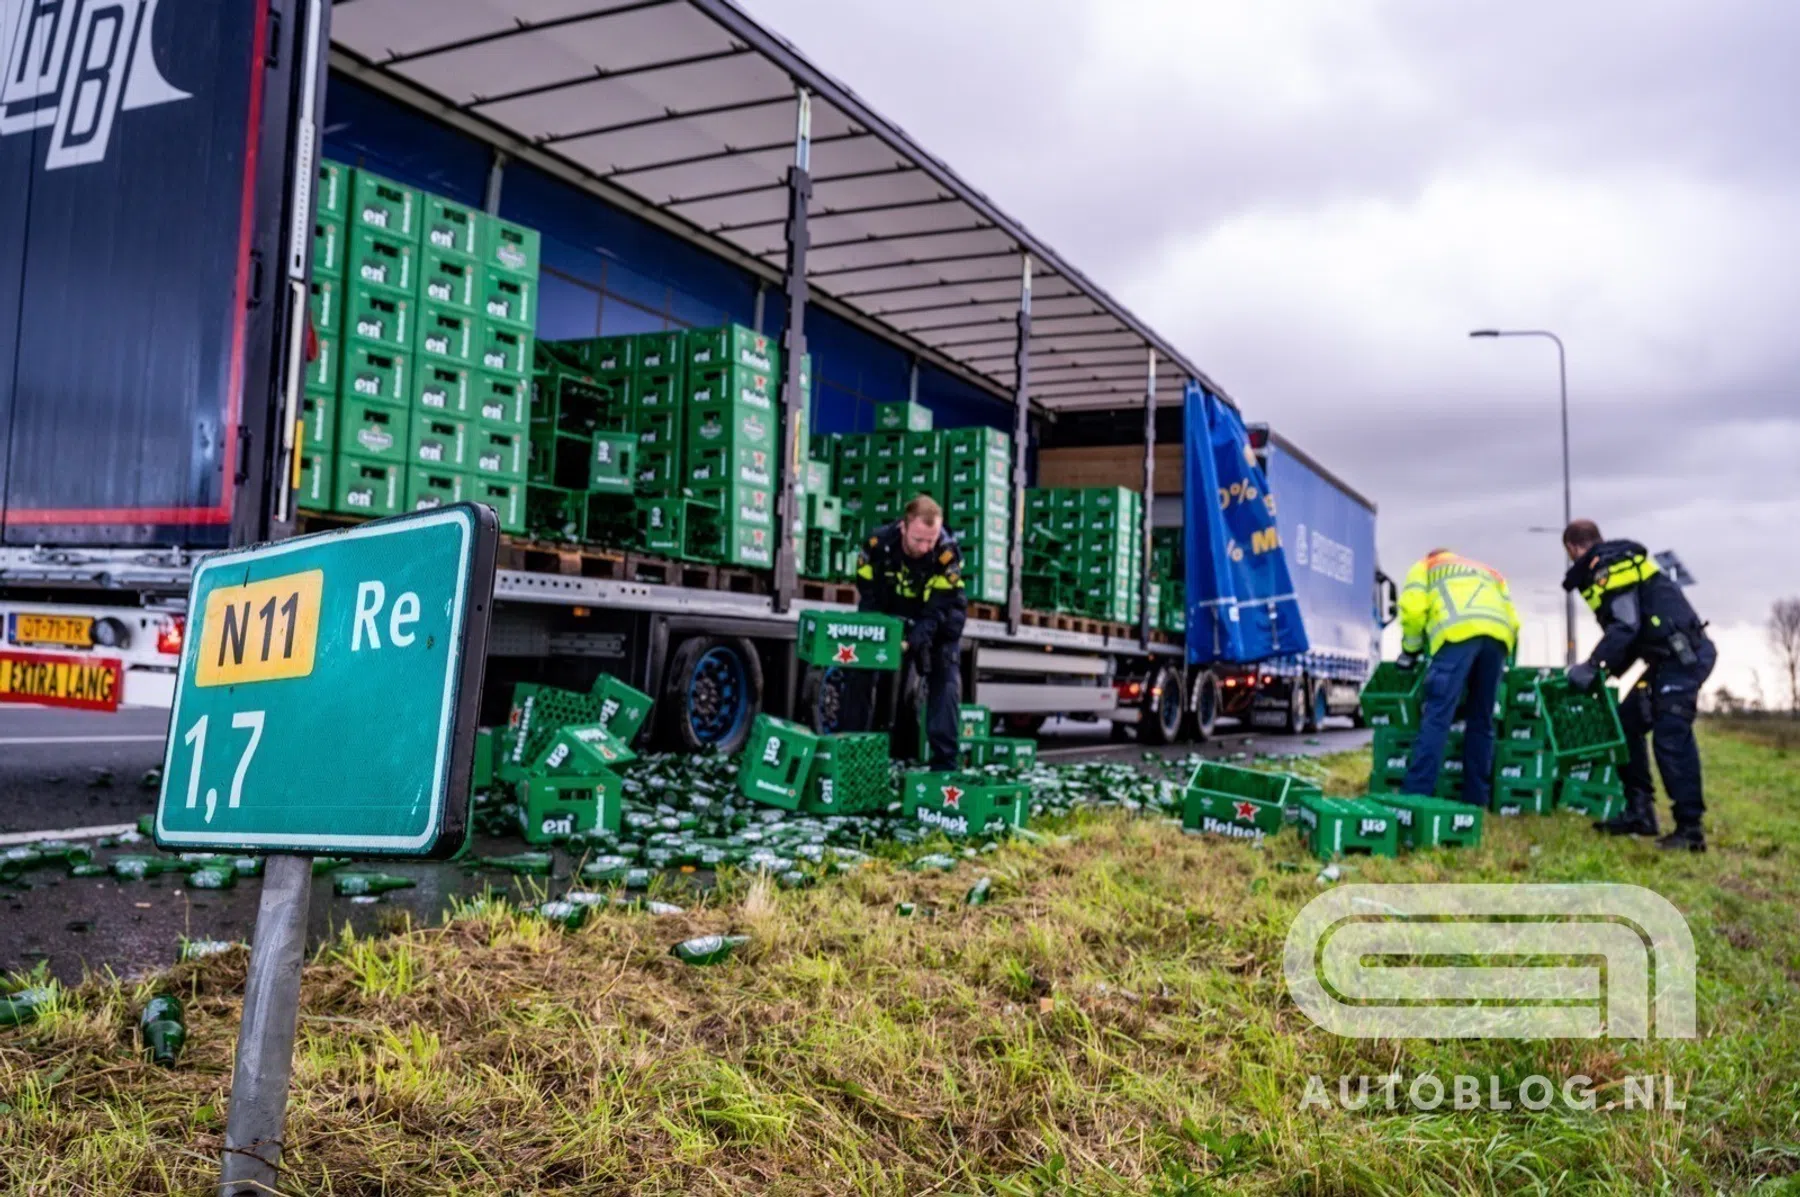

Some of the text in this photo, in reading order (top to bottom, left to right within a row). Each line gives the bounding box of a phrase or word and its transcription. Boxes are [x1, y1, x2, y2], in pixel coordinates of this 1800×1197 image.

[218, 580, 421, 667] N11 Re
[826, 623, 886, 641] Heinek
[11, 660, 113, 702] EXTRA LANG
[763, 736, 780, 766] en
[184, 710, 266, 824] 1,7
[541, 813, 574, 834] en
[916, 806, 966, 834] Heinek
